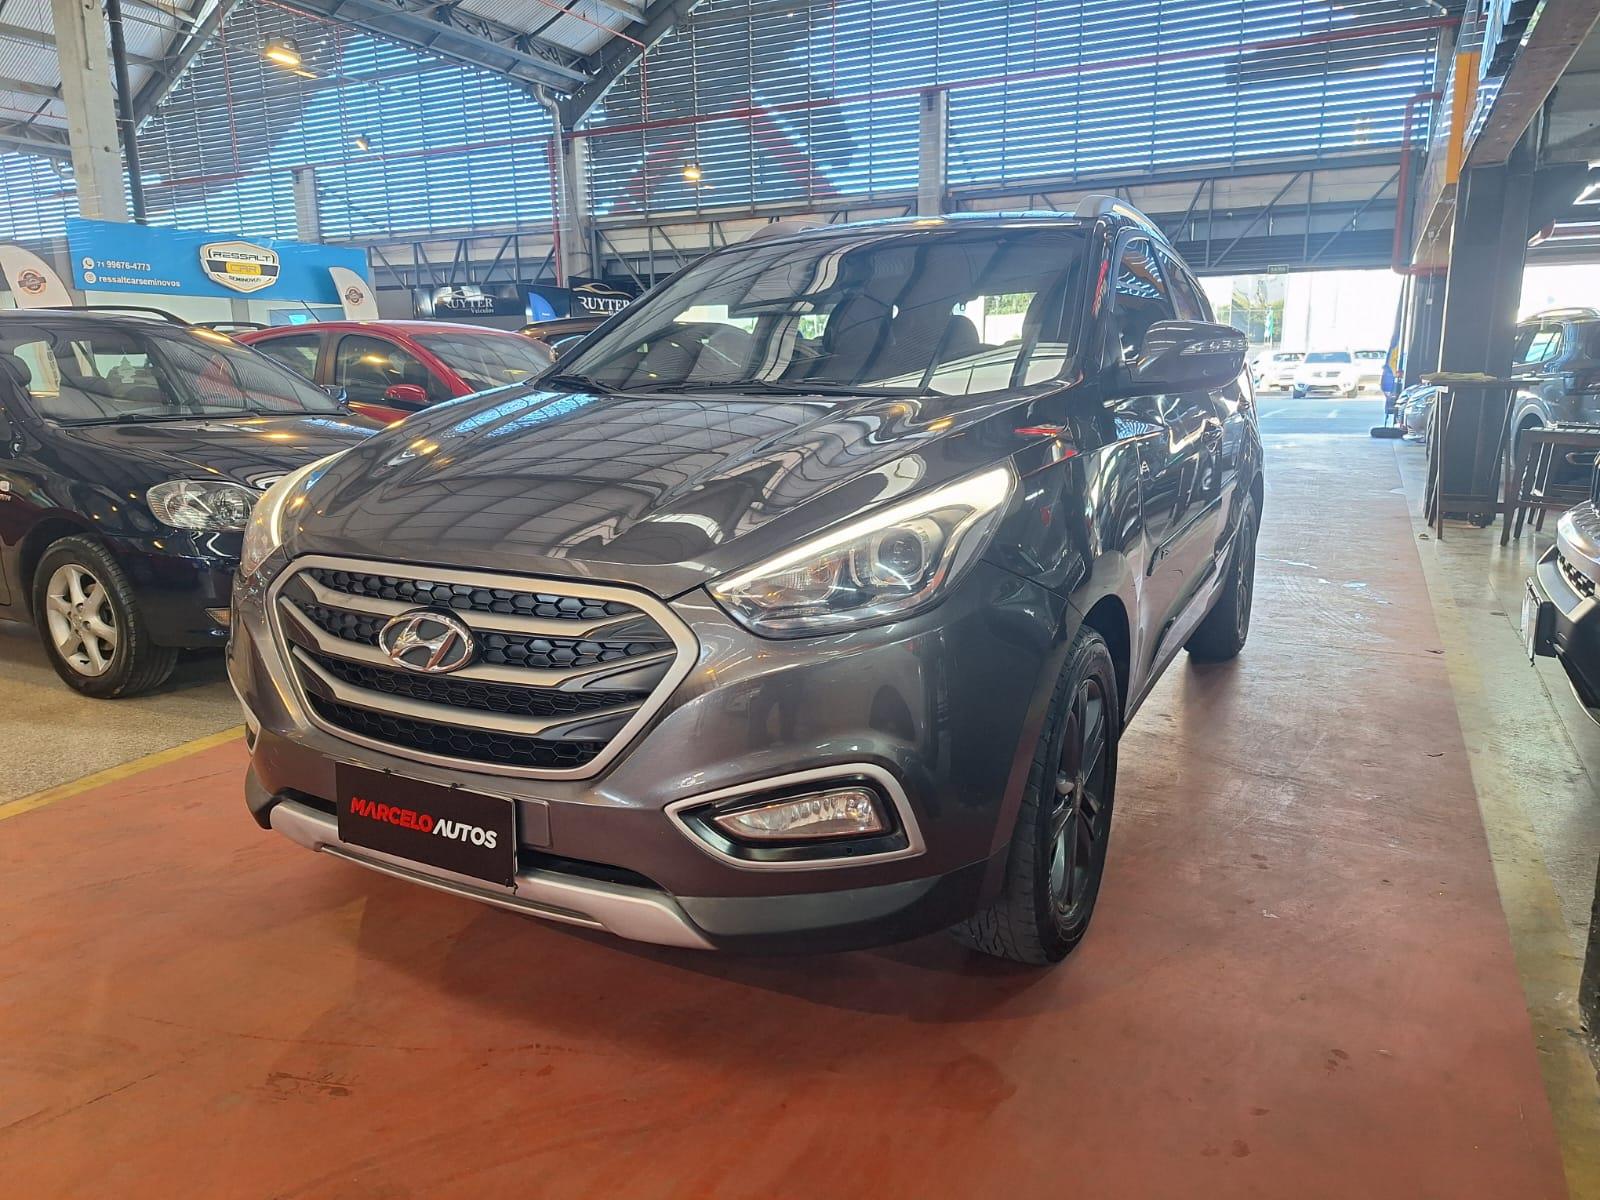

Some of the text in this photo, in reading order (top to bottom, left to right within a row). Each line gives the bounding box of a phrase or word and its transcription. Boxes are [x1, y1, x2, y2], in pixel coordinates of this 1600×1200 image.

[212, 251, 271, 262] RESSALT
[98, 275, 181, 288] ressaltcarseminovos
[351, 797, 498, 849] MARCELO AUTOS
